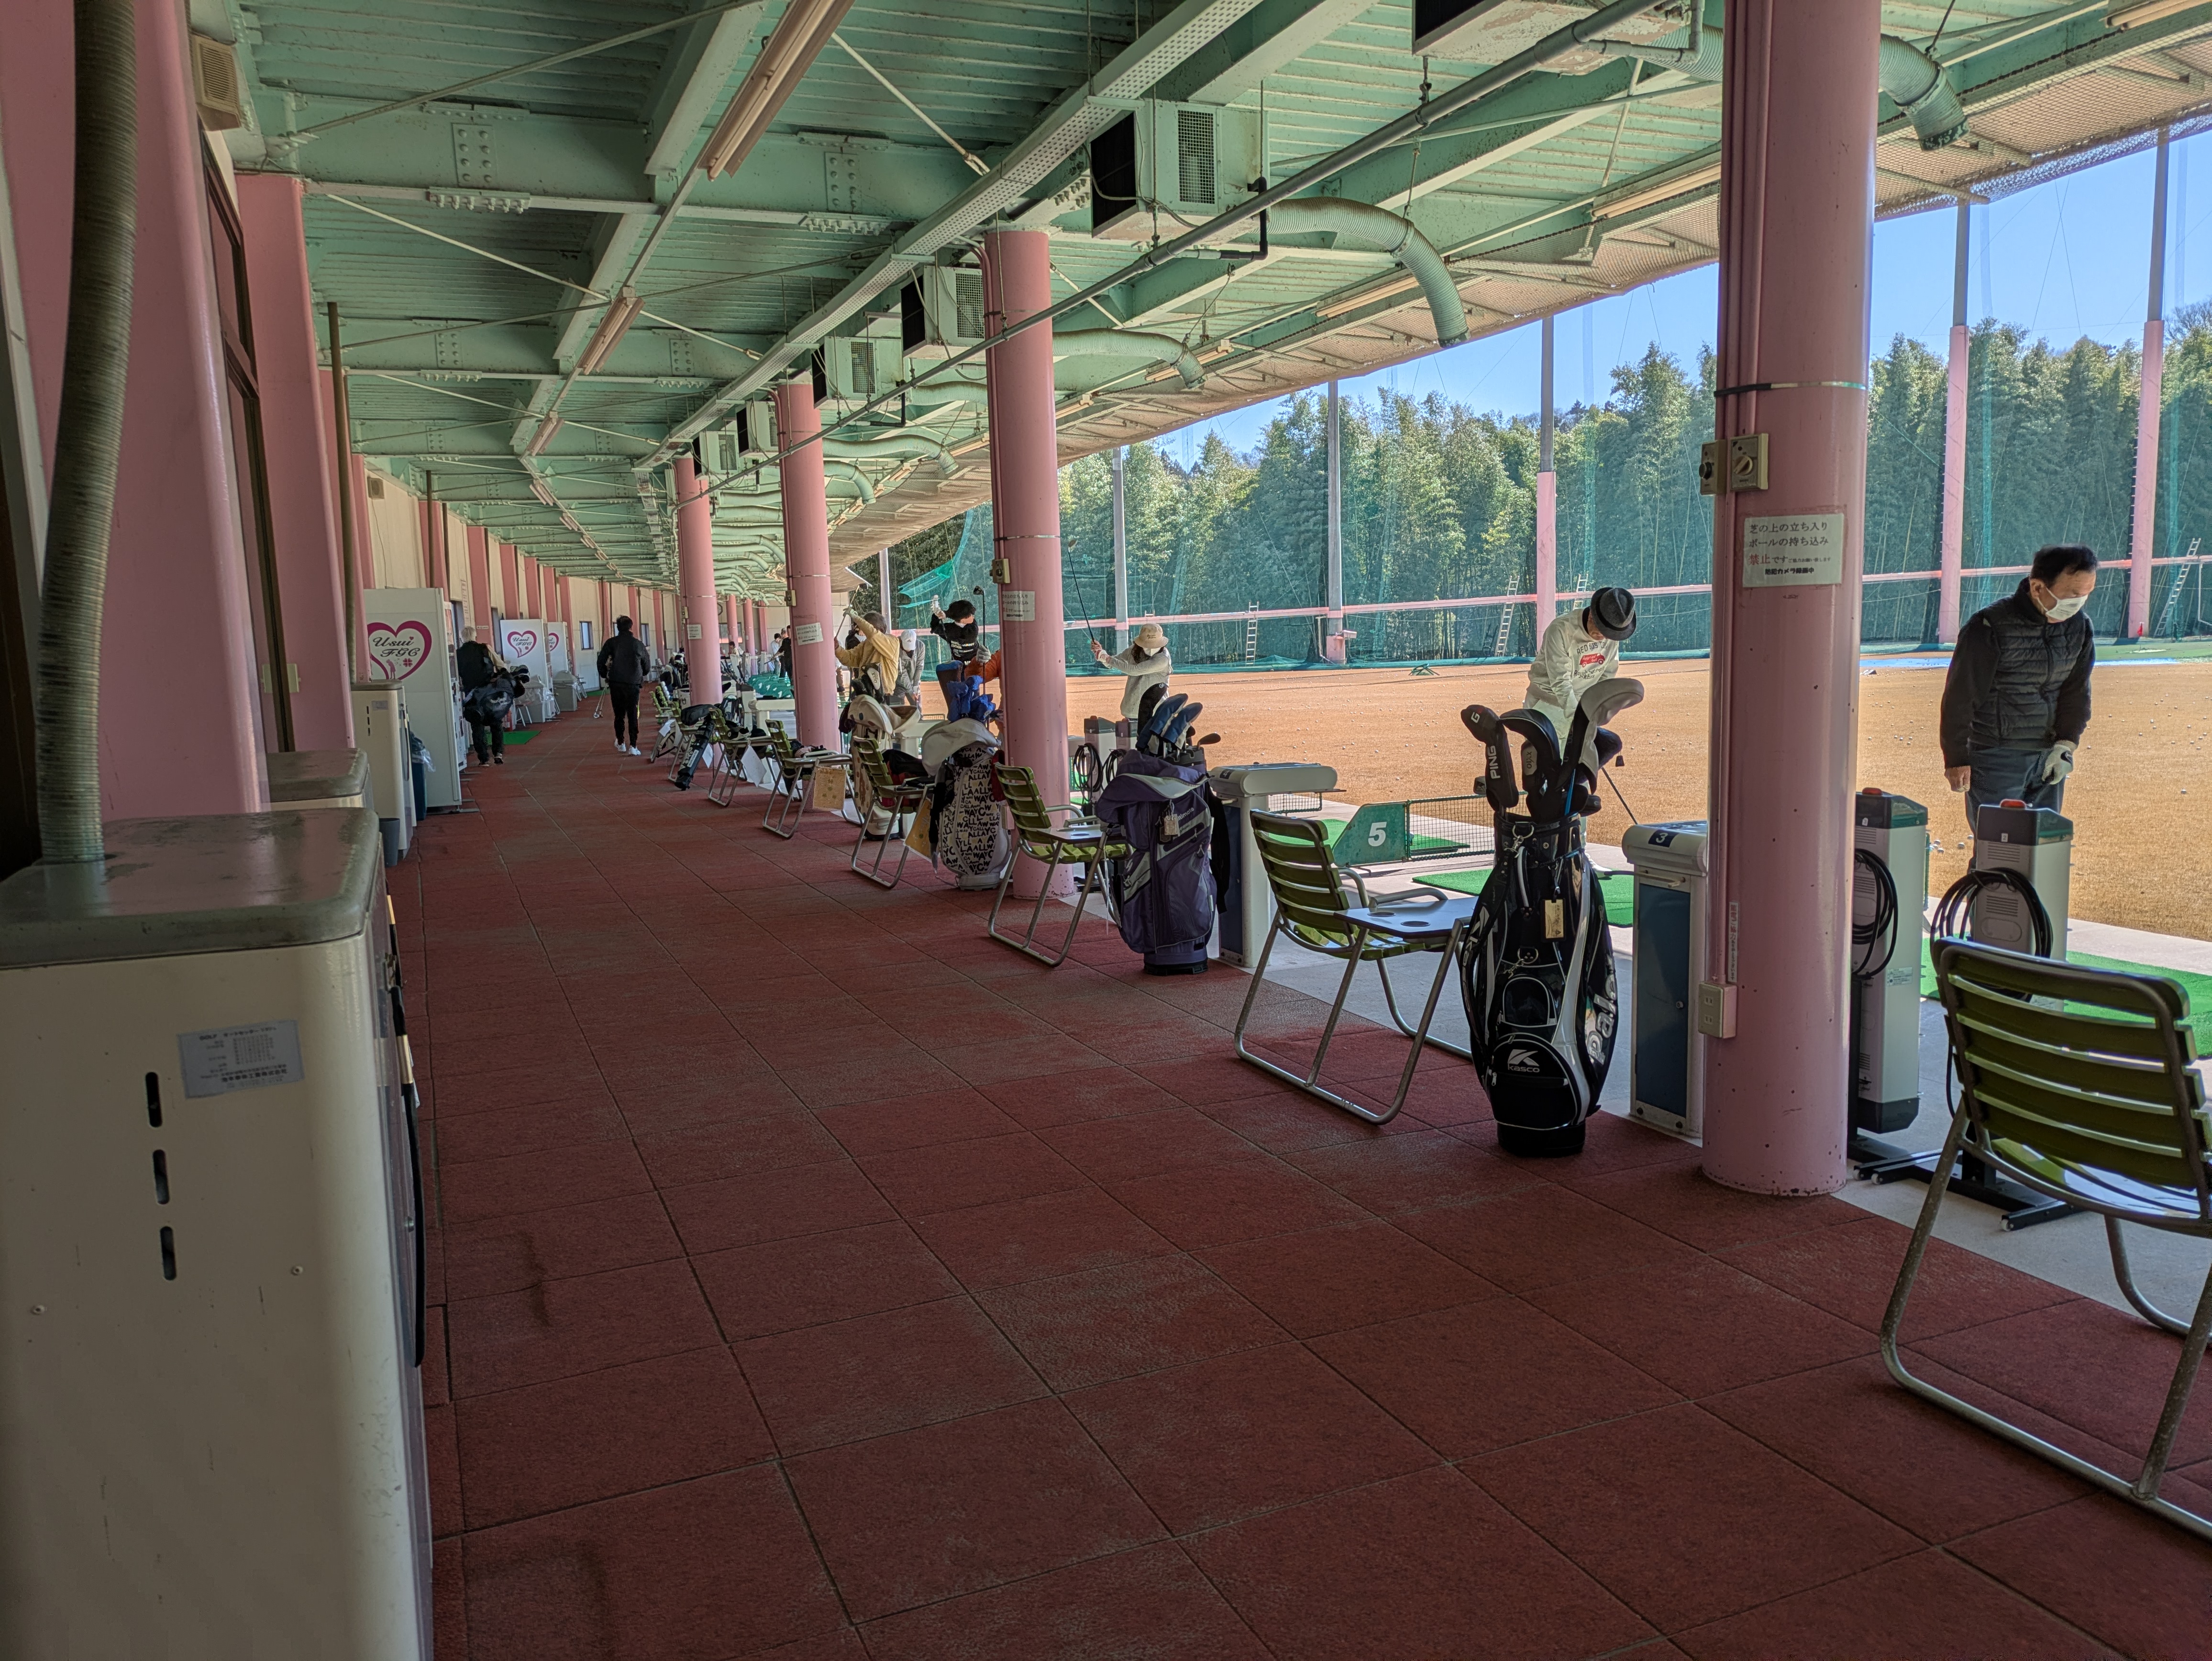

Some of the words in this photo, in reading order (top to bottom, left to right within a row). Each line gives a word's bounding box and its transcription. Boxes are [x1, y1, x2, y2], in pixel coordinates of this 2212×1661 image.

[1749, 521, 1828, 534] 芝の上の立ち入り
[1748, 536, 1829, 548] ボールの持ち込み
[373, 636, 415, 647] Usui
[380, 647, 420, 657] FGC
[1577, 644, 1588, 654] RED
[1487, 745, 1501, 780] PING
[1177, 807, 1194, 821] ltimate
[1368, 821, 1387, 847] 5
[1656, 832, 1669, 843] 3
[1507, 1063, 1540, 1073] kasco
